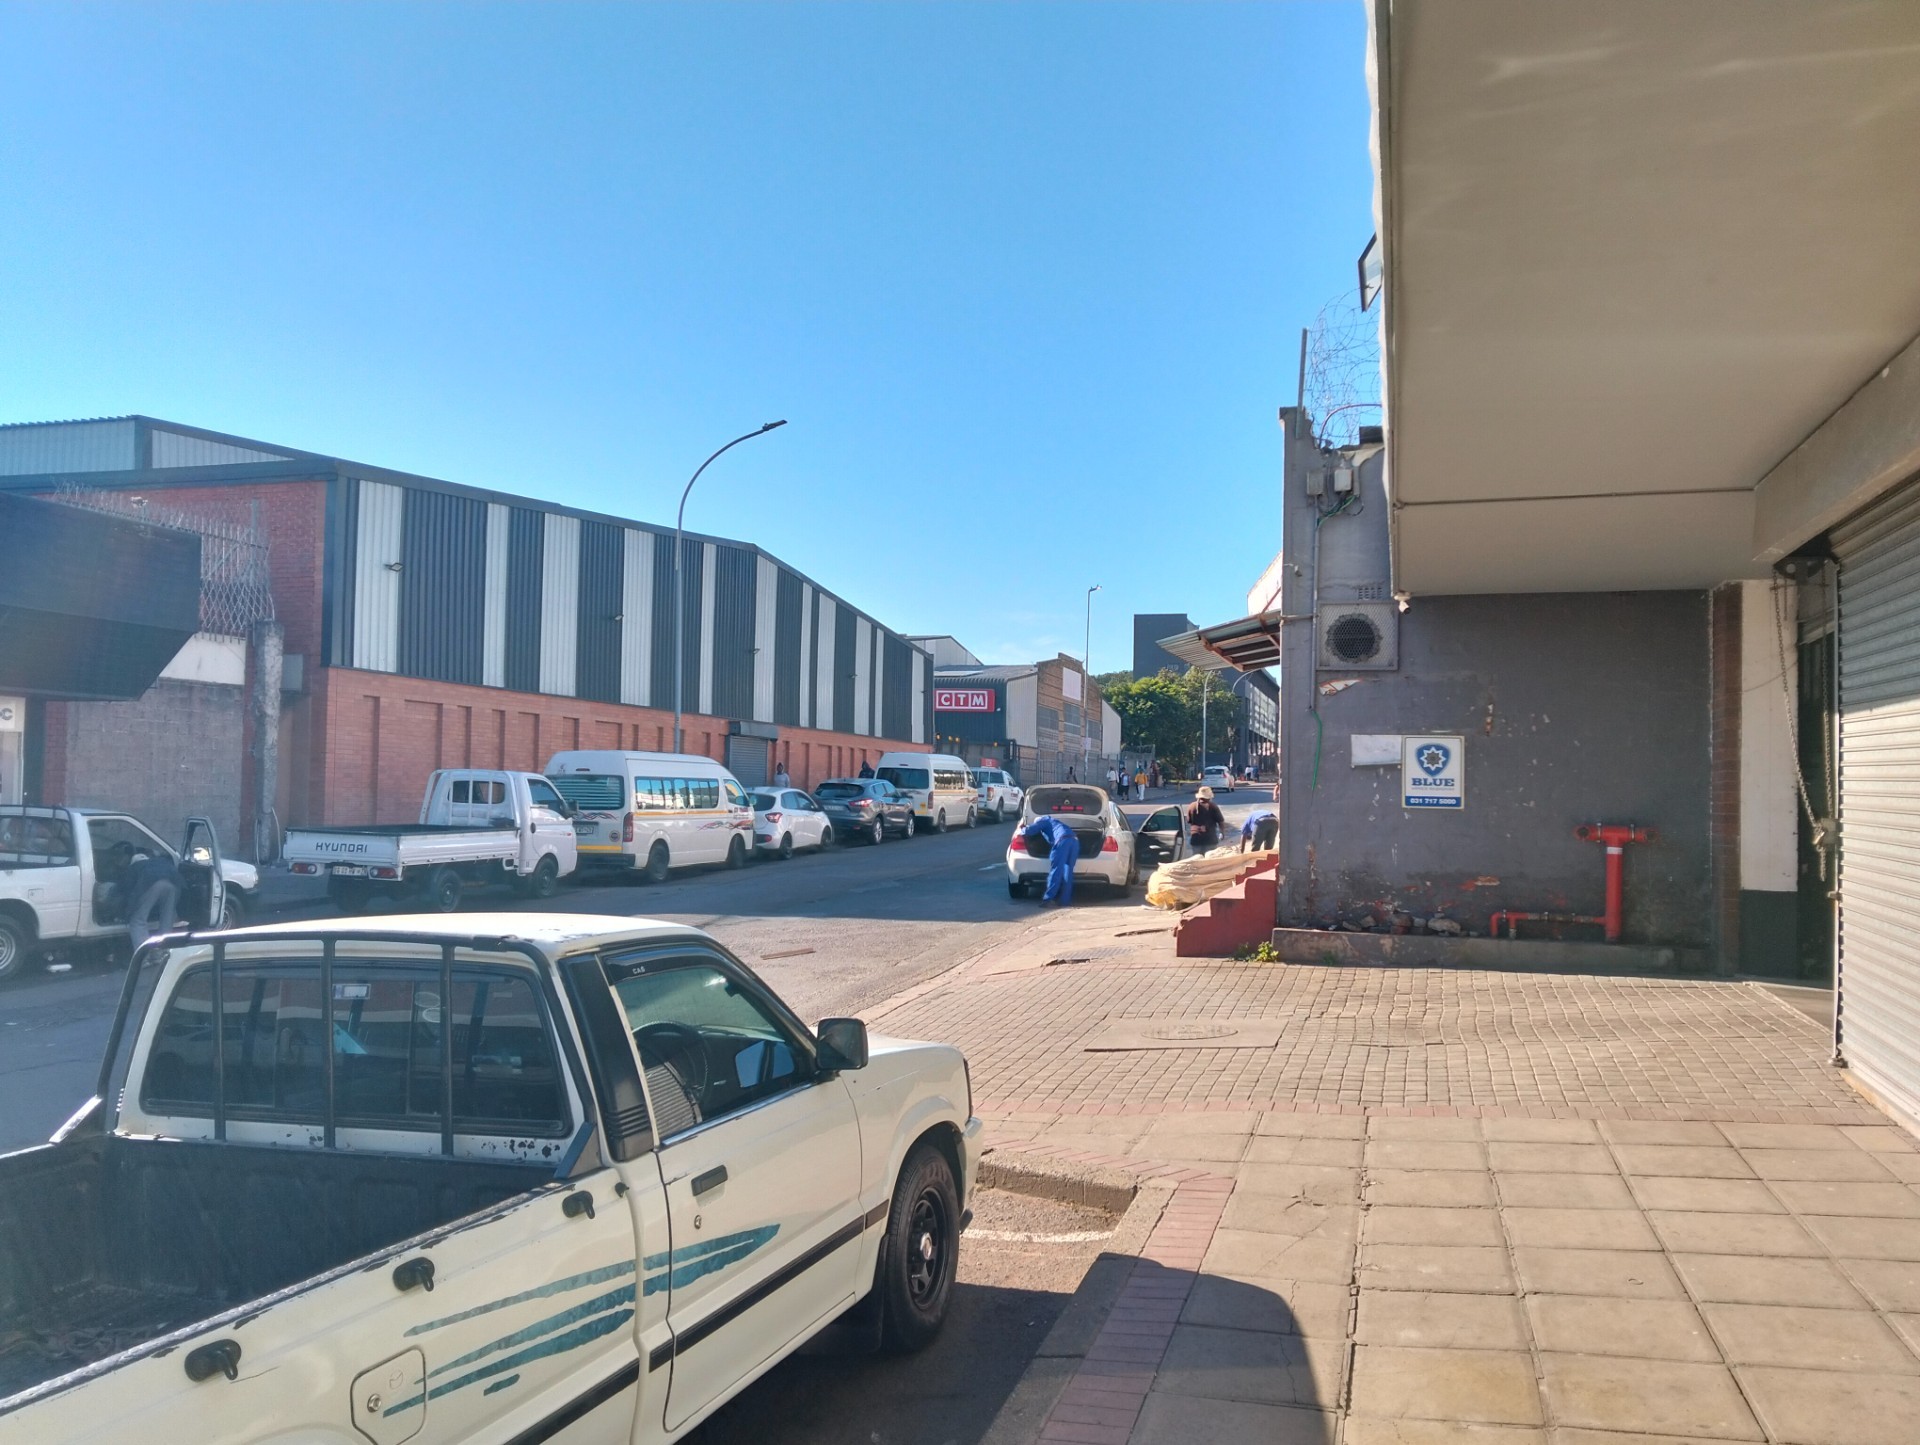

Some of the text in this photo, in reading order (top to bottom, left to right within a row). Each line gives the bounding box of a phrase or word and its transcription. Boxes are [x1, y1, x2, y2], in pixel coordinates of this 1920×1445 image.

[940, 693, 984, 706] CTM
[1411, 777, 1455, 787] BLUE
[315, 842, 368, 853] HYUNDAI
